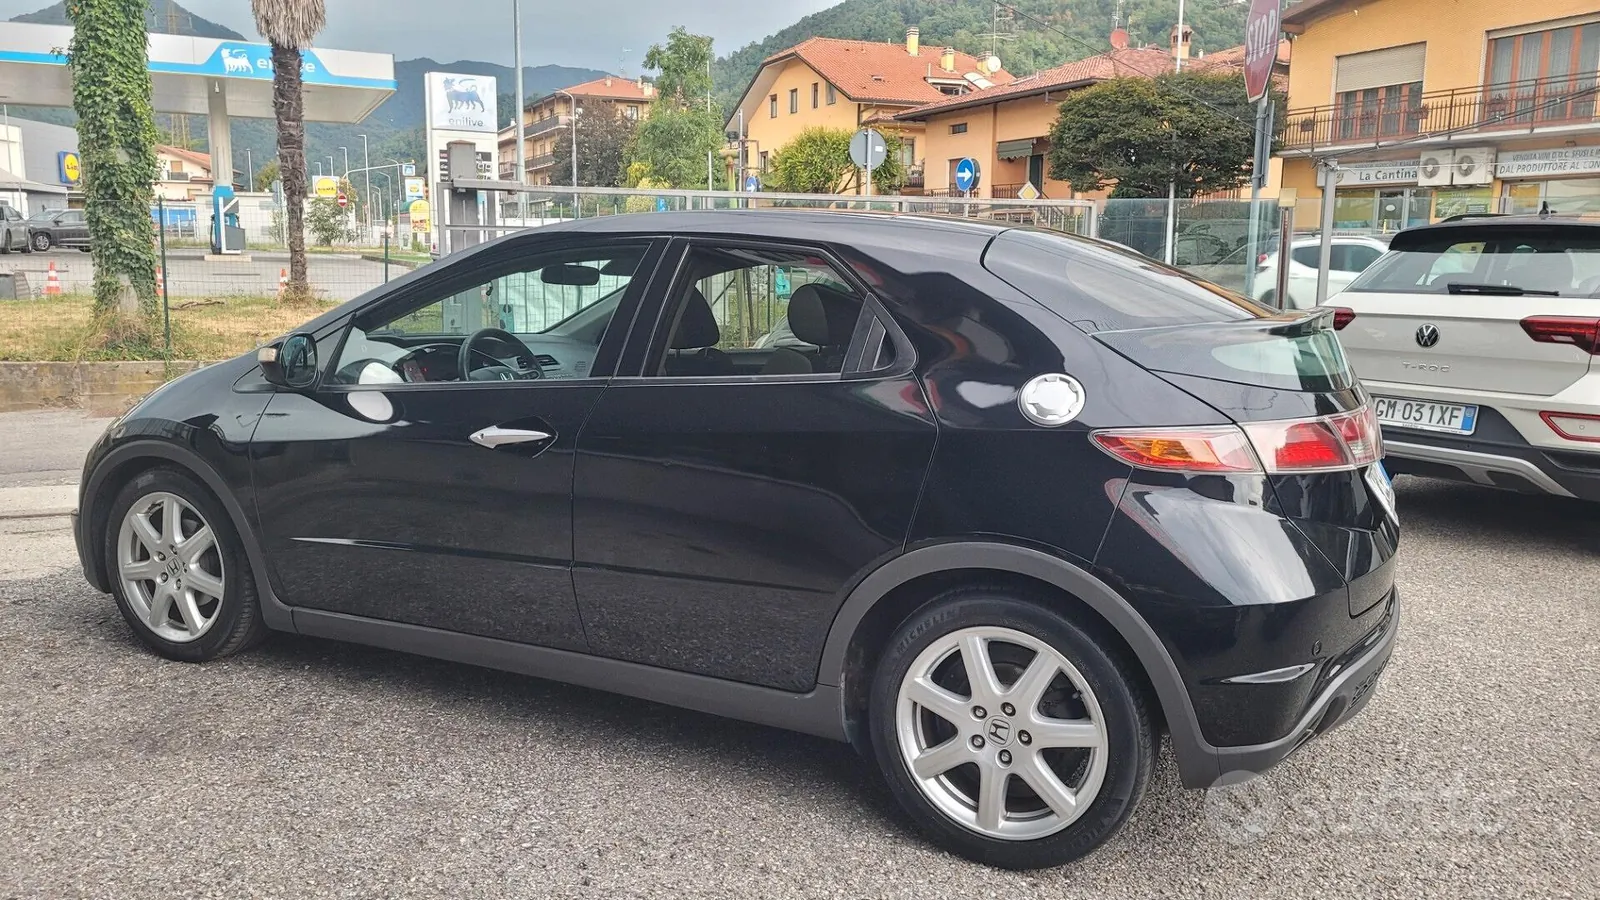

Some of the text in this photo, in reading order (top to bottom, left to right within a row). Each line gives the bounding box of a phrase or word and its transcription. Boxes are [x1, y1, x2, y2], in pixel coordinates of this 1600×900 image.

[1246, 9, 1276, 65] STOP
[448, 116, 484, 127] enilive
[1500, 164, 1514, 174] DAL
[1516, 161, 1567, 173] PRODUTTORE
[1569, 161, 1580, 170] AL
[1359, 168, 1418, 181] La Cantina
[1402, 361, 1450, 373] T-ROC
[1375, 399, 1462, 426] GM 031XF
